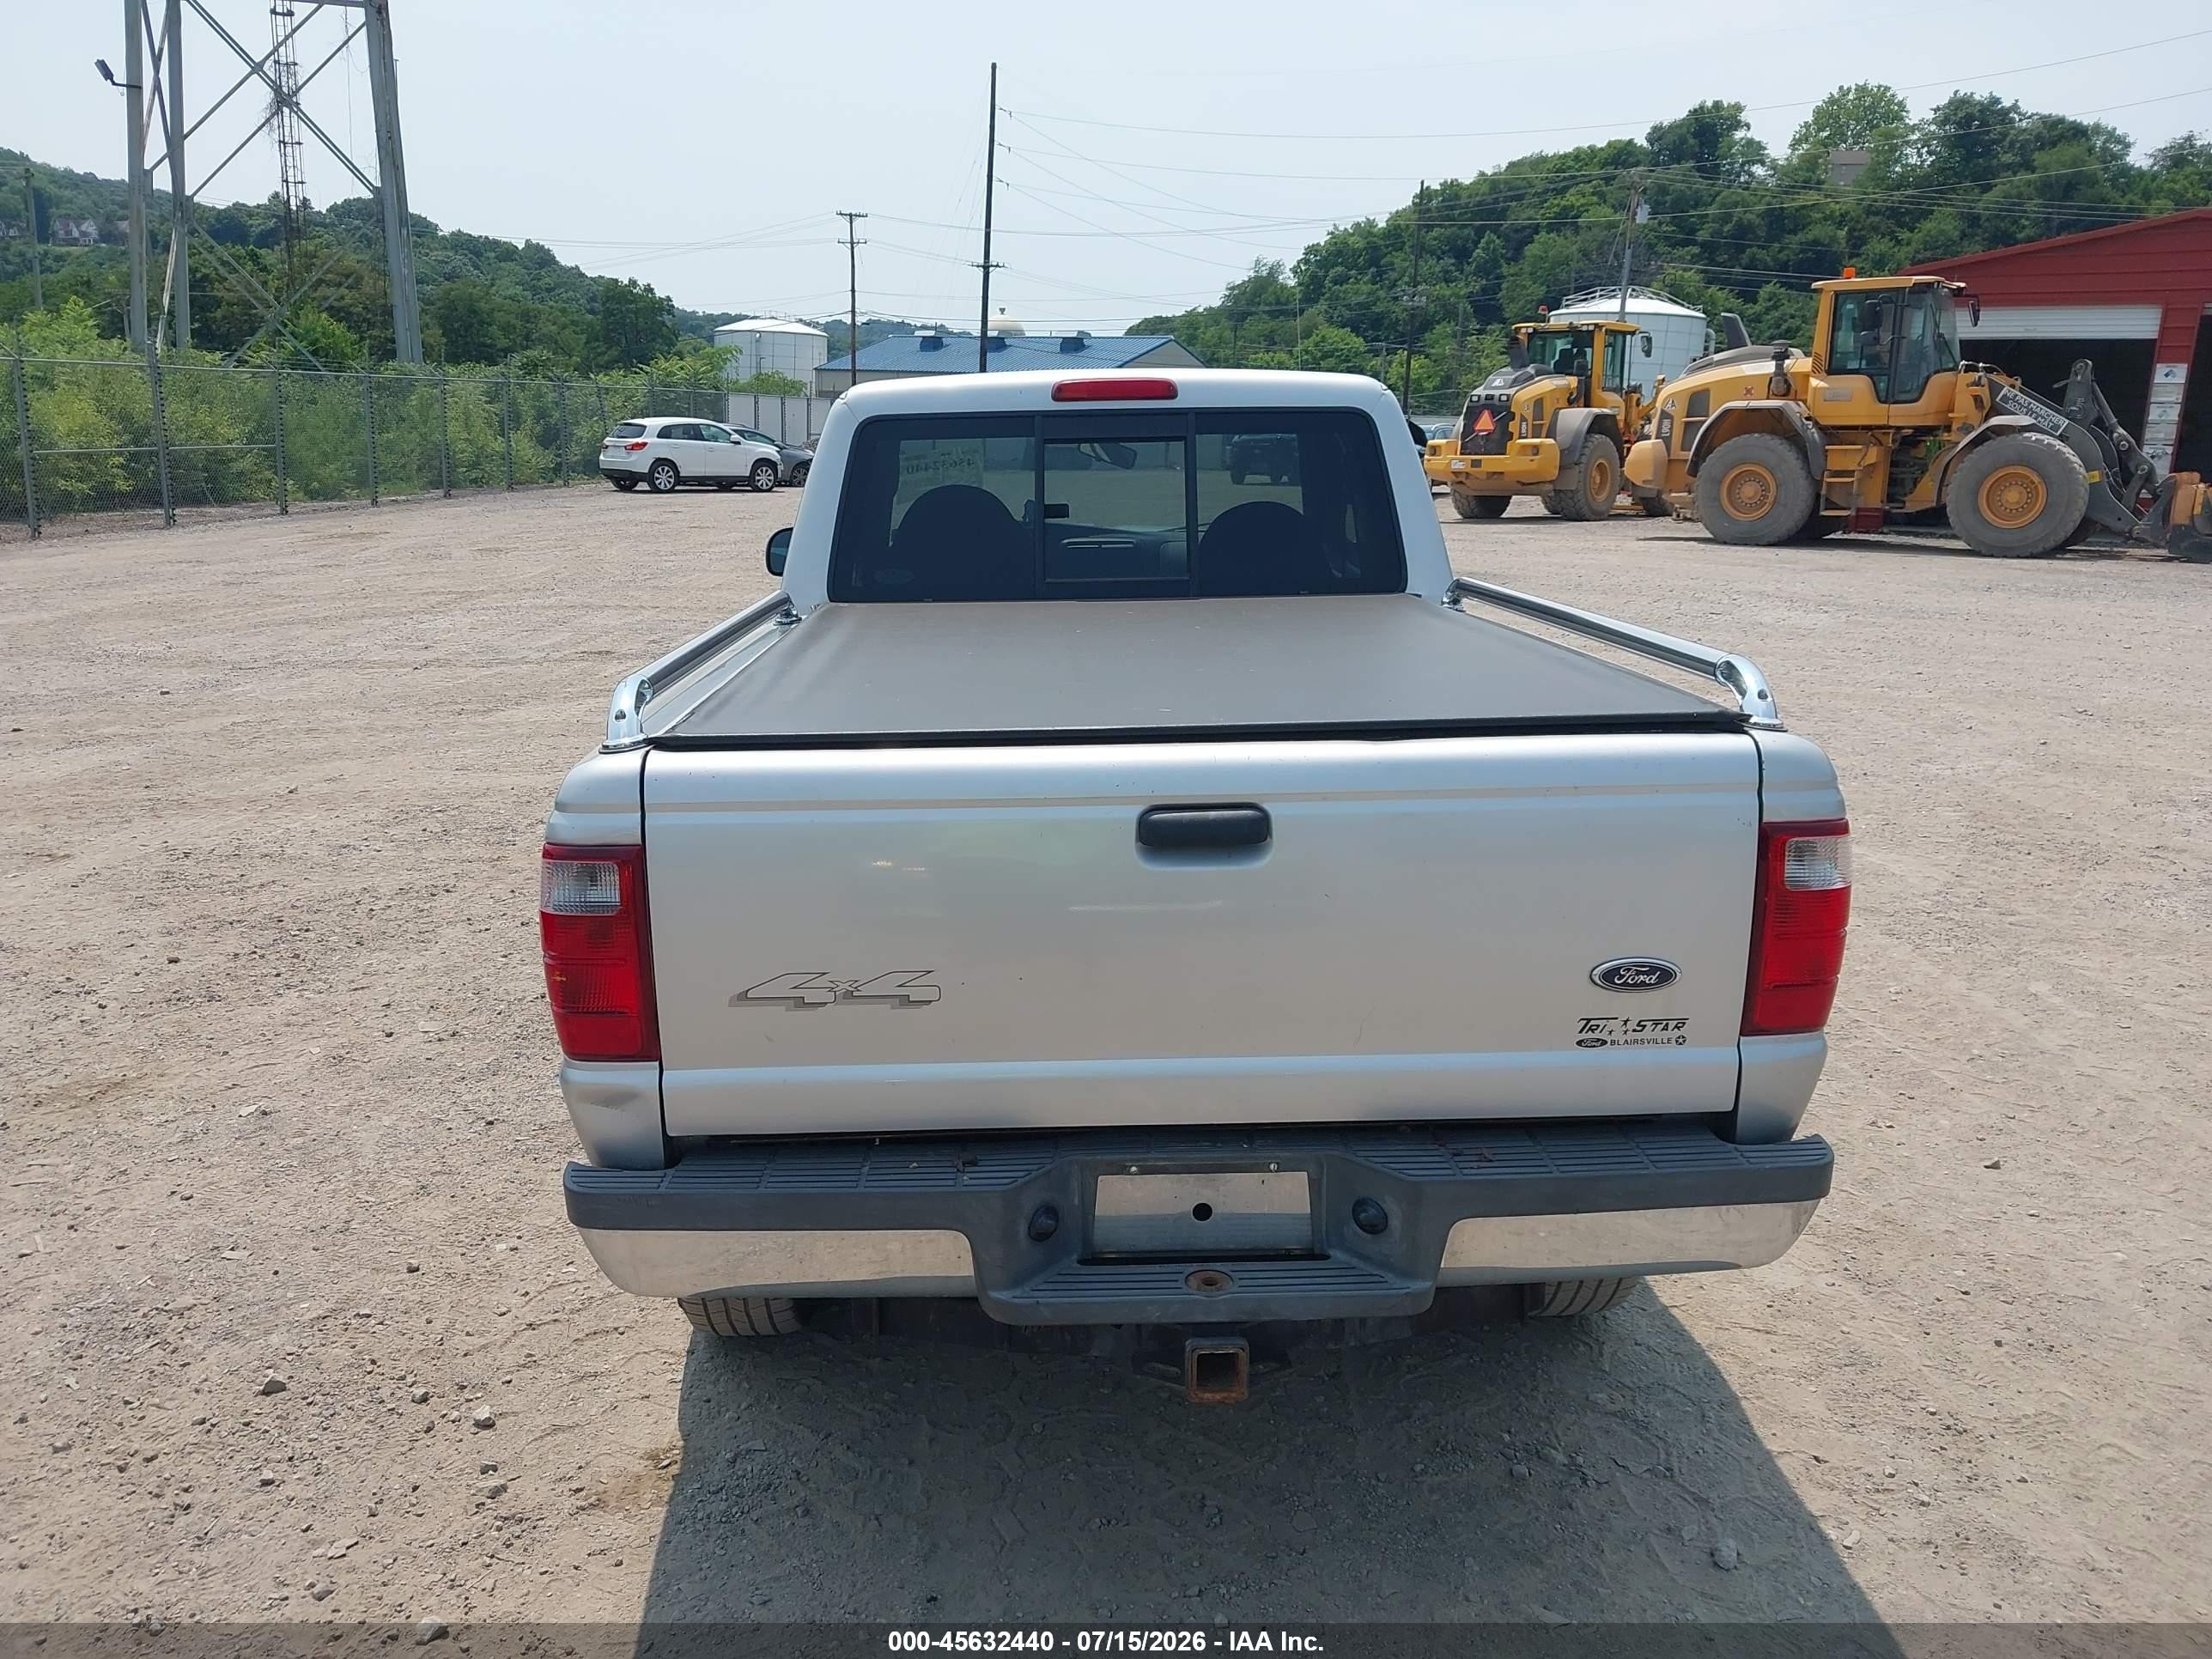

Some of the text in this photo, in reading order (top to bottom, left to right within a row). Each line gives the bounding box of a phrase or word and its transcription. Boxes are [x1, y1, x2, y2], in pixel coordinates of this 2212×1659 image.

[2003, 390, 2064, 427] NE PAS MARCHER
[2007, 399, 2027, 415] SOUS
[1613, 966, 1661, 984] Ford
[1632, 1018, 1690, 1033] STAR
[1609, 1037, 1673, 1046] BLAIRSVILLE
